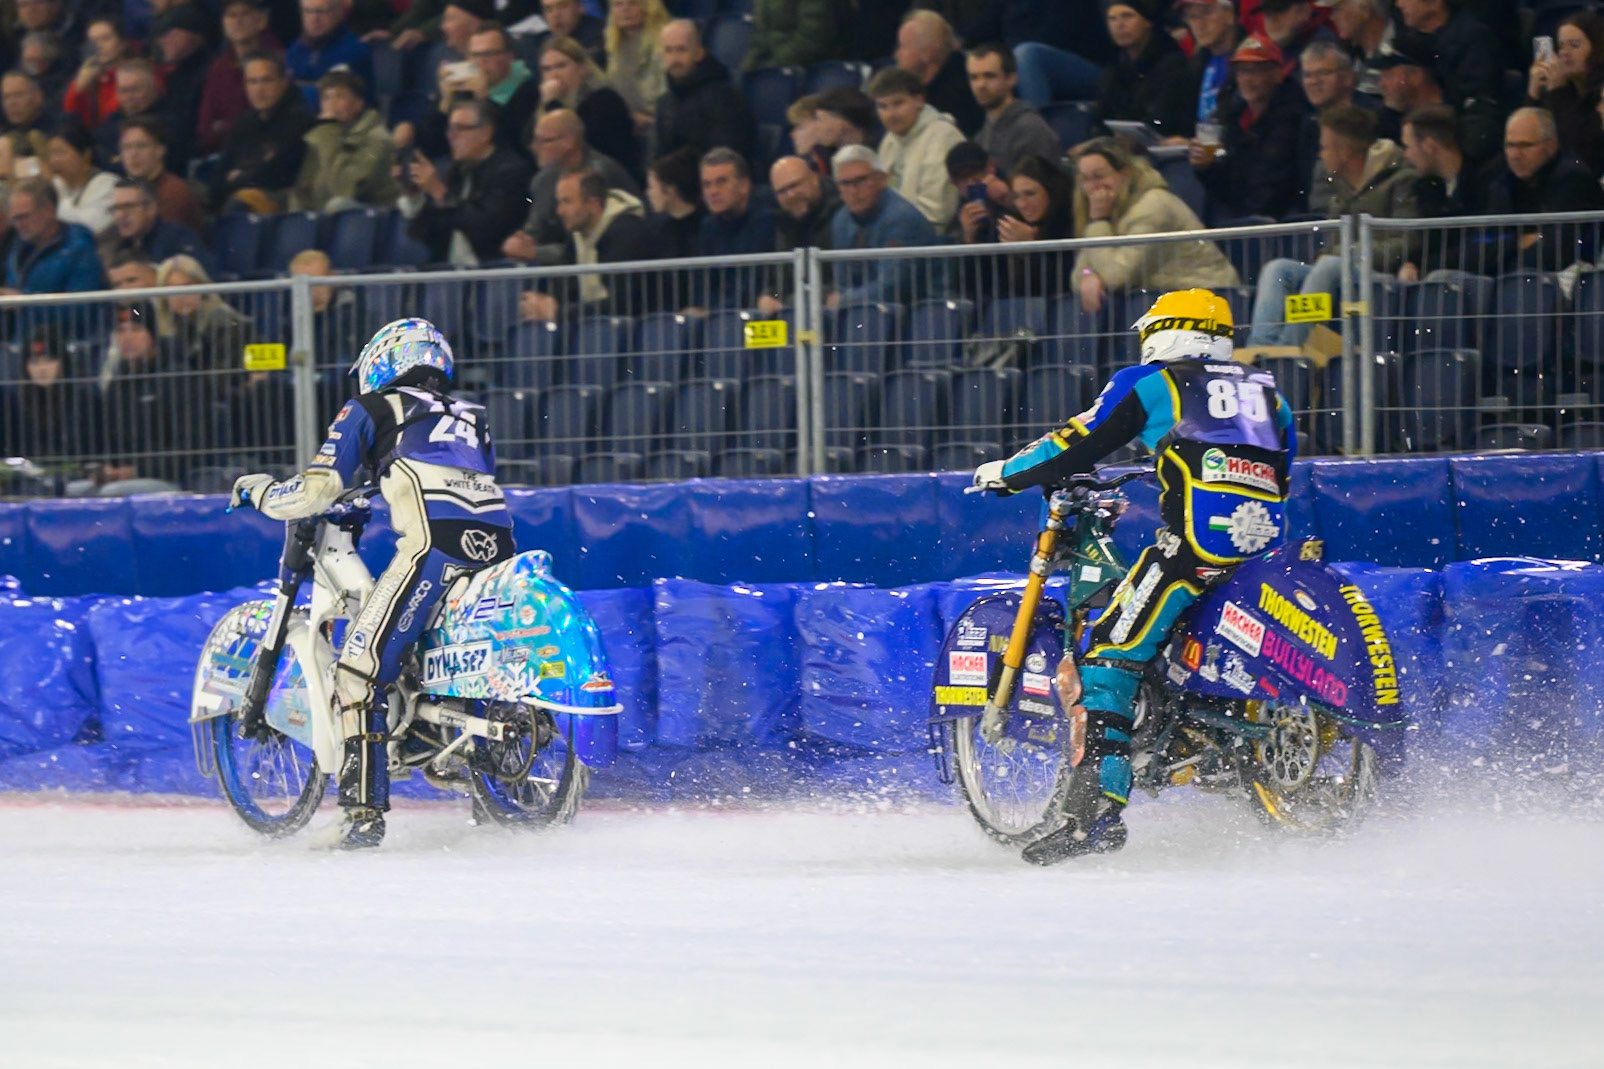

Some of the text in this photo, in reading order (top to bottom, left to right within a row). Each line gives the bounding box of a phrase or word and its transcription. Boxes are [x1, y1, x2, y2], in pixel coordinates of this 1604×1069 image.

[1206, 378, 1268, 422] 85
[428, 403, 479, 449] 24
[444, 479, 496, 494] WHITE DEATH
[463, 471, 477, 481] THE
[1223, 604, 1263, 645] HACHER
[1258, 582, 1339, 661] THORWESTEN
[427, 648, 488, 681] DYNASET
[1338, 584, 1399, 706] THORWESTEN
[1261, 630, 1348, 708] BULLYLAND
